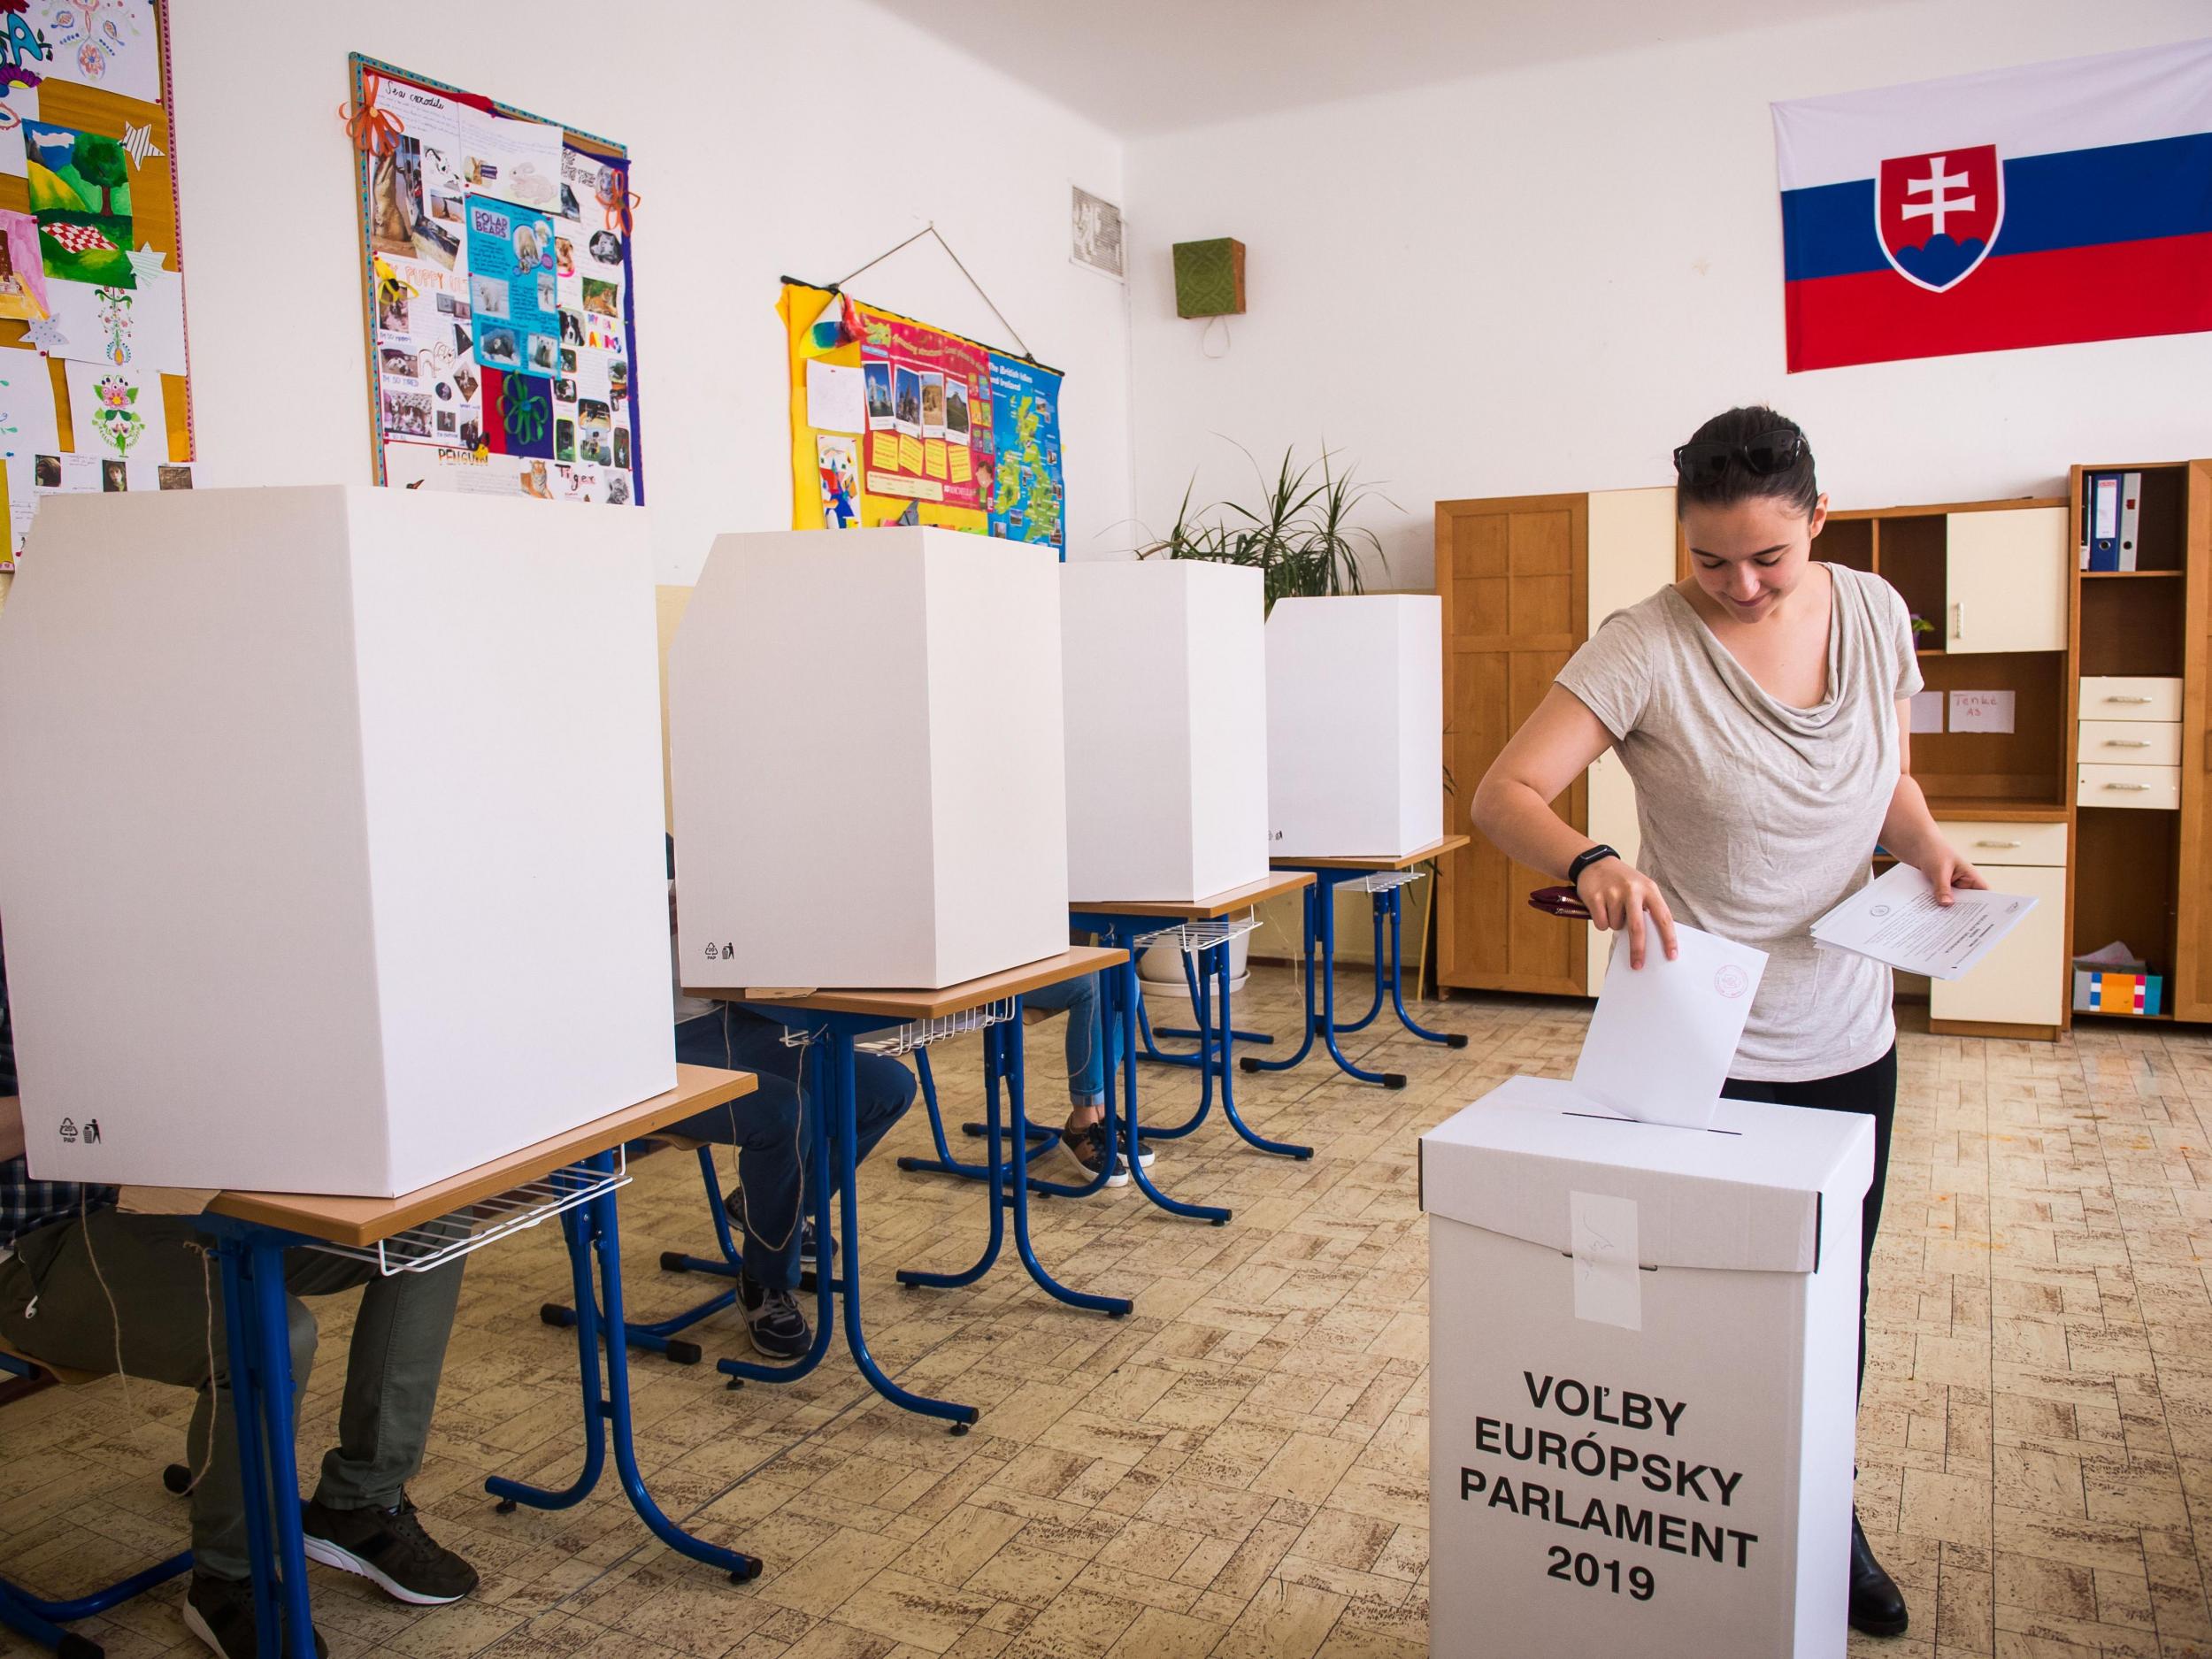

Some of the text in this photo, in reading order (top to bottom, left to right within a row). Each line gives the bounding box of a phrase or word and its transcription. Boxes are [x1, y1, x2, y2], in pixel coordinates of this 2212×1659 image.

[385, 81, 405, 98] Sea
[475, 211, 508, 227] POLAR
[476, 221, 507, 238] BEARS
[999, 365, 1019, 380] British
[1000, 378, 1022, 392] Ireland
[554, 463, 595, 492] Tiger
[1523, 1371, 1687, 1437] VOĽBY
[1475, 1416, 1744, 1508] EURÓPSKY
[1460, 1466, 1759, 1569] PARLAMENT
[1547, 1544, 1655, 1602] 2019
